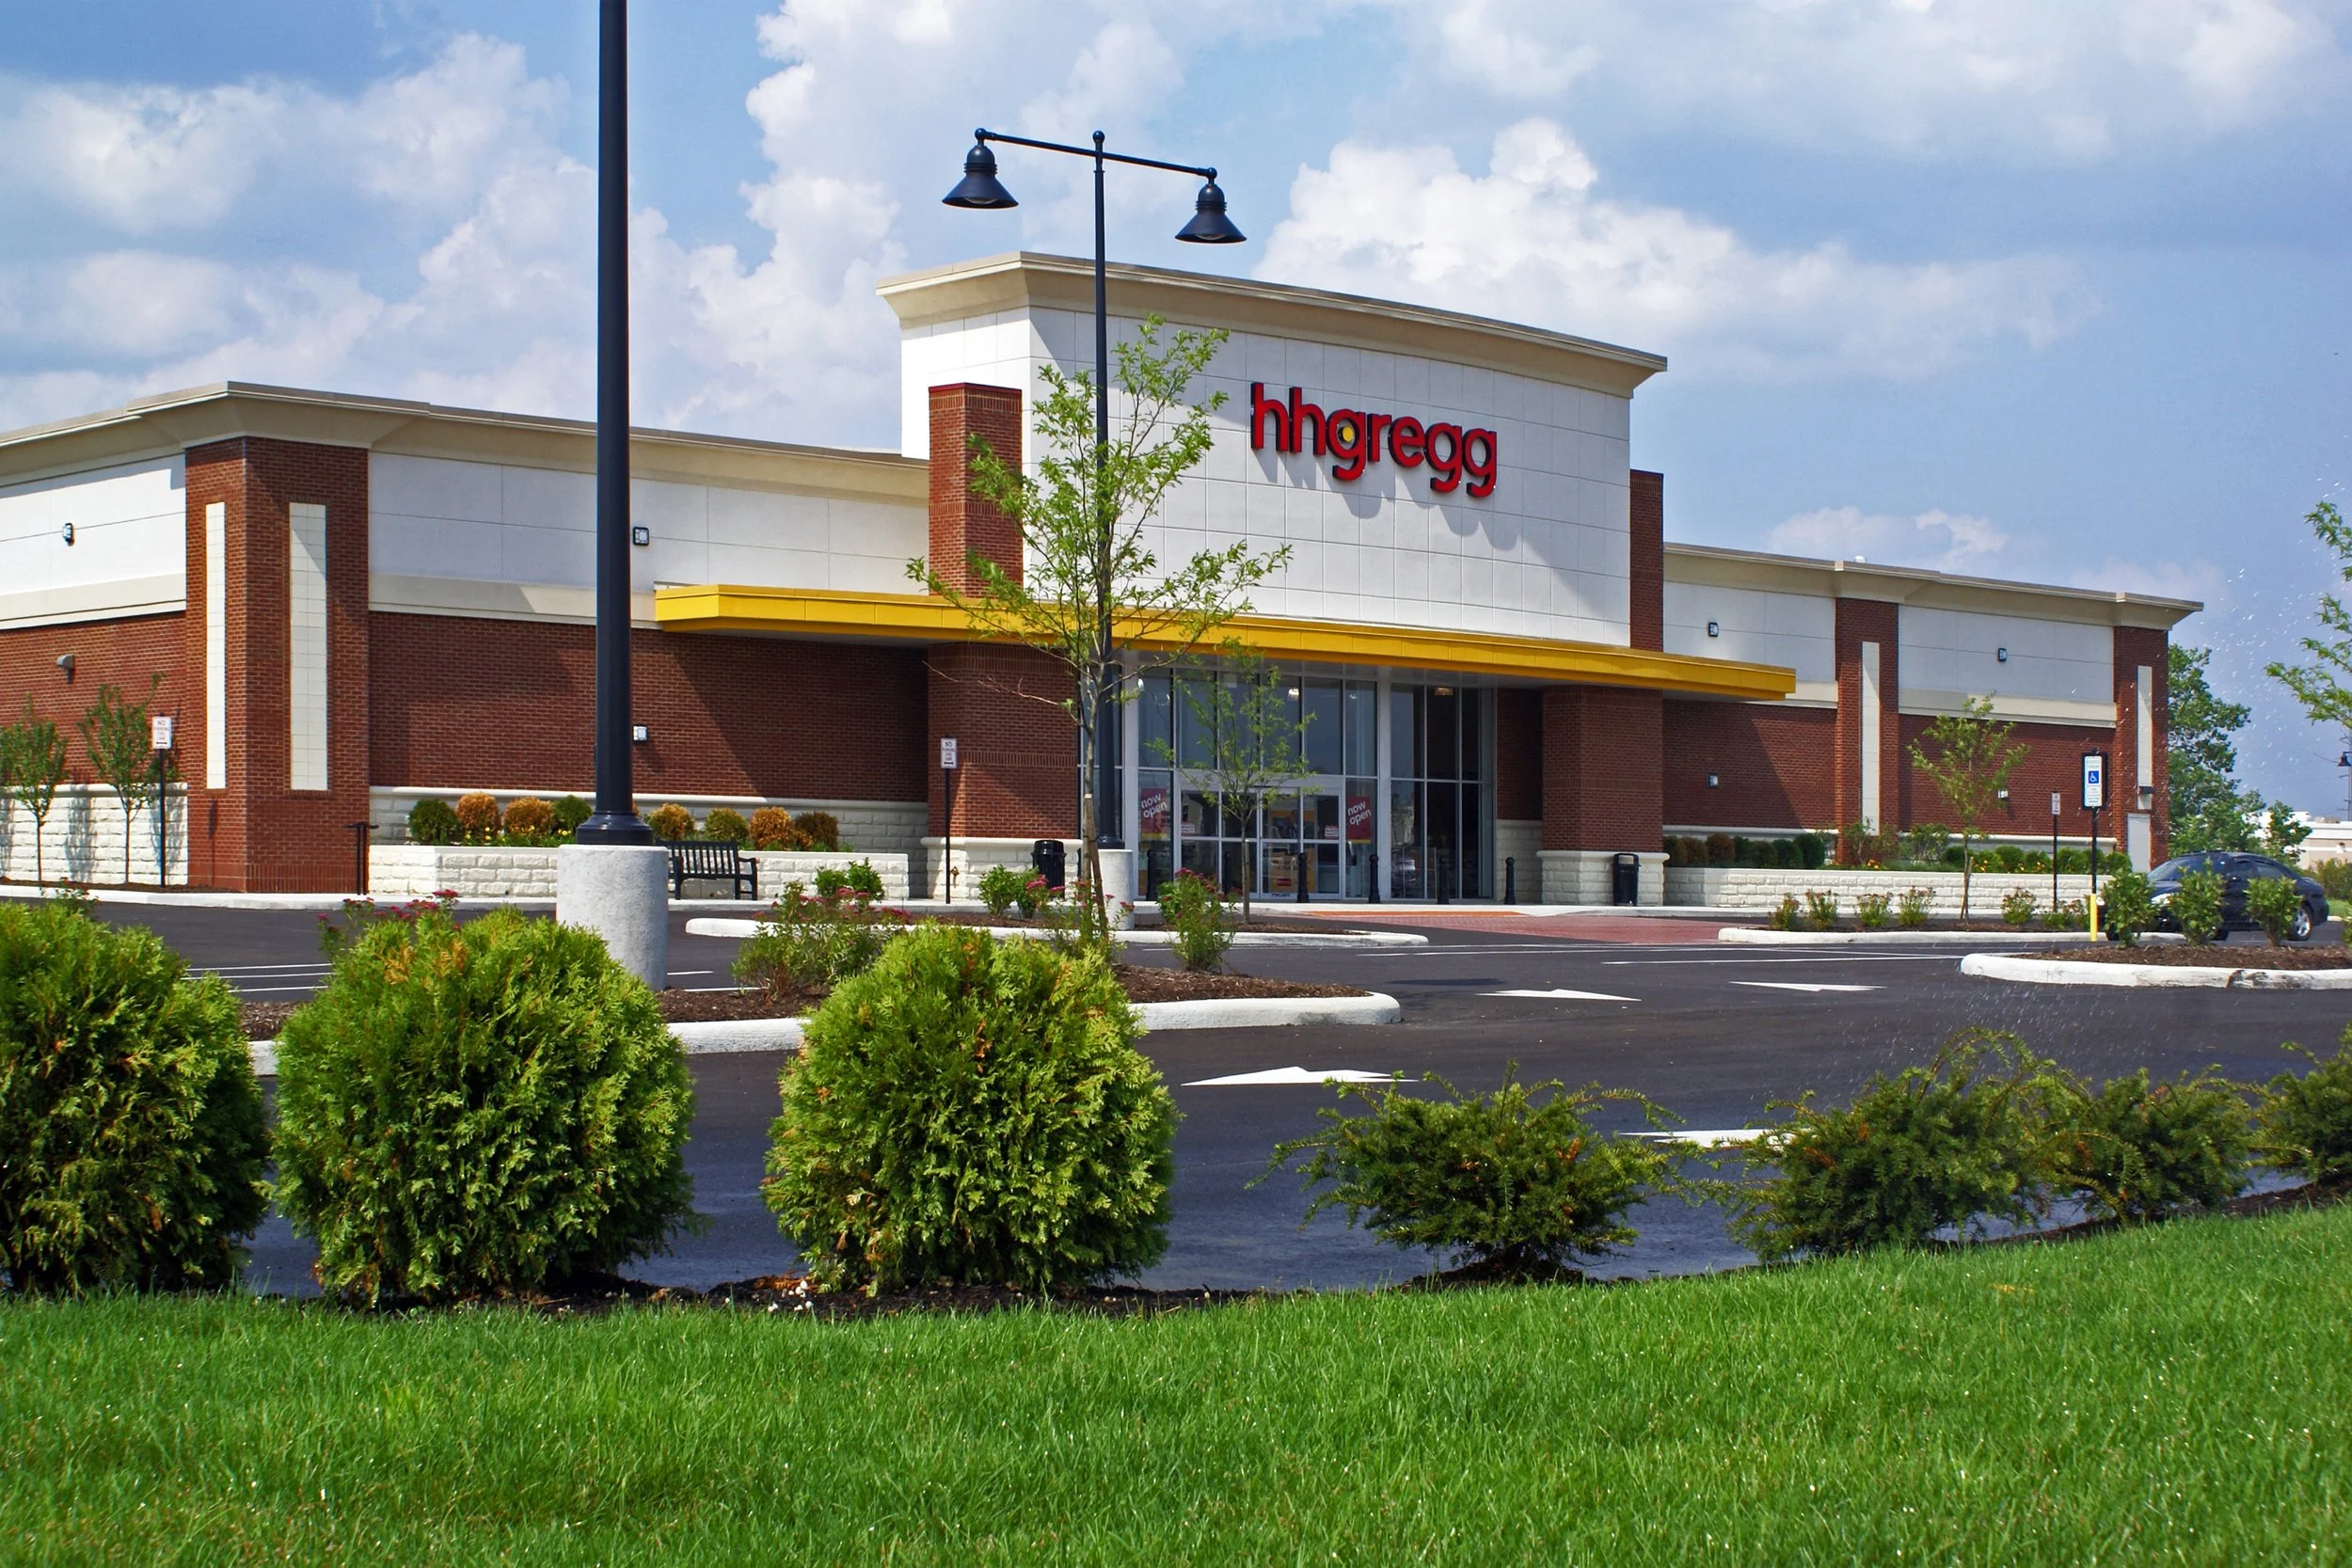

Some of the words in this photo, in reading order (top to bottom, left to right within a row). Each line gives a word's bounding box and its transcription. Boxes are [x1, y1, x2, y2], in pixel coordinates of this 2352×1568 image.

[1250, 382, 1498, 498] hhgregg
[1140, 793, 1162, 809] now
[1143, 801, 1168, 818] open
[1347, 800, 1366, 816] now
[1349, 809, 1372, 826] open
